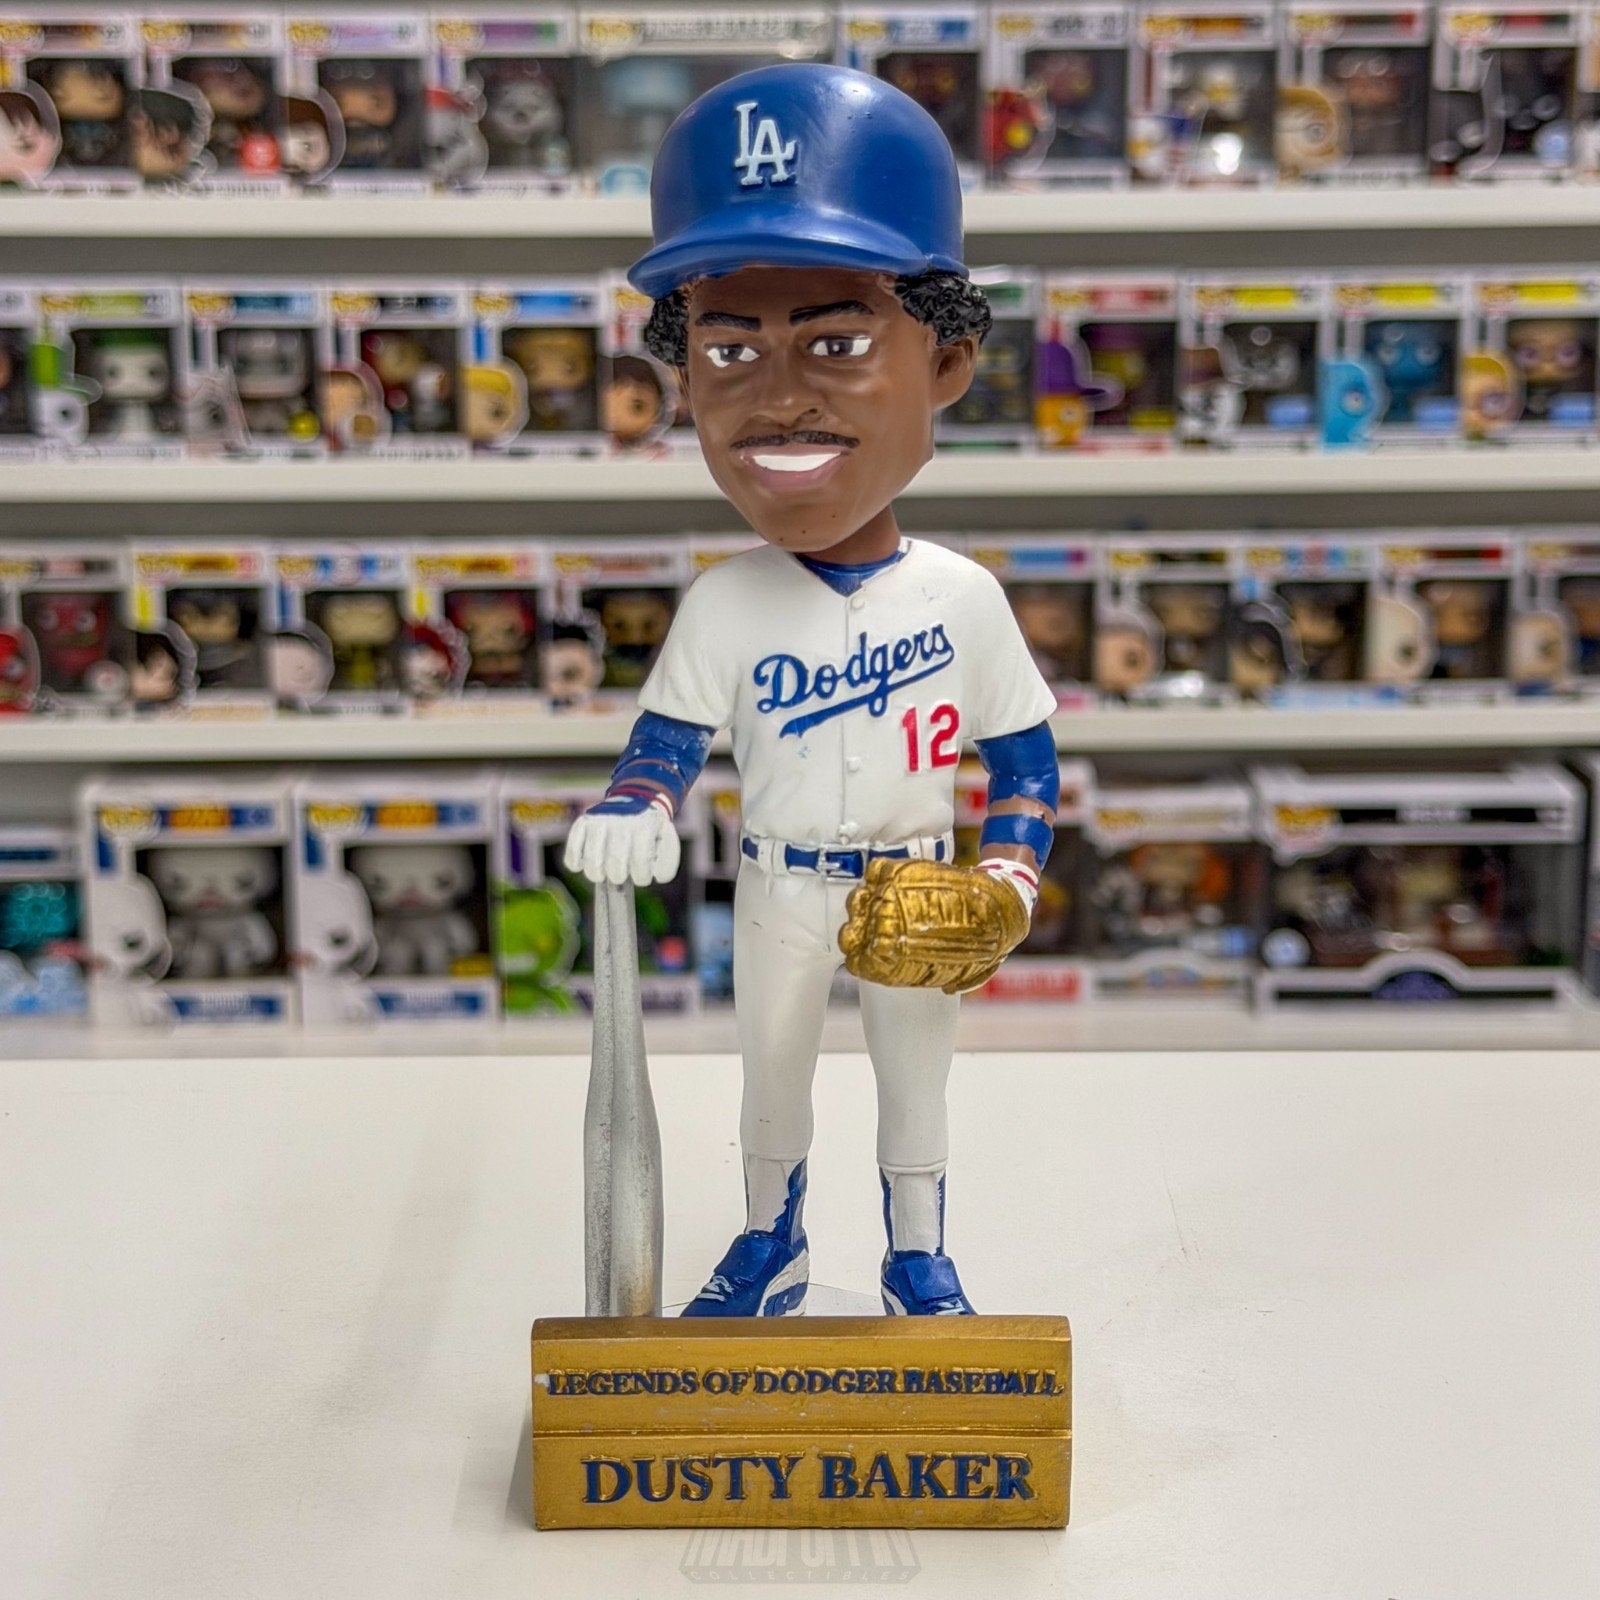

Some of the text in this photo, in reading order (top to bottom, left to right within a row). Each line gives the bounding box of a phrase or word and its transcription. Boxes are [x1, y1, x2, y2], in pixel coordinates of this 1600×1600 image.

[735, 102, 797, 186] LA
[754, 624, 954, 720] Dodgers
[902, 704, 959, 772] 12
[547, 1366, 1064, 1396] LEGENDS OF DODGER BASEBALL
[580, 1451, 1040, 1503] DUSTY BAKER
